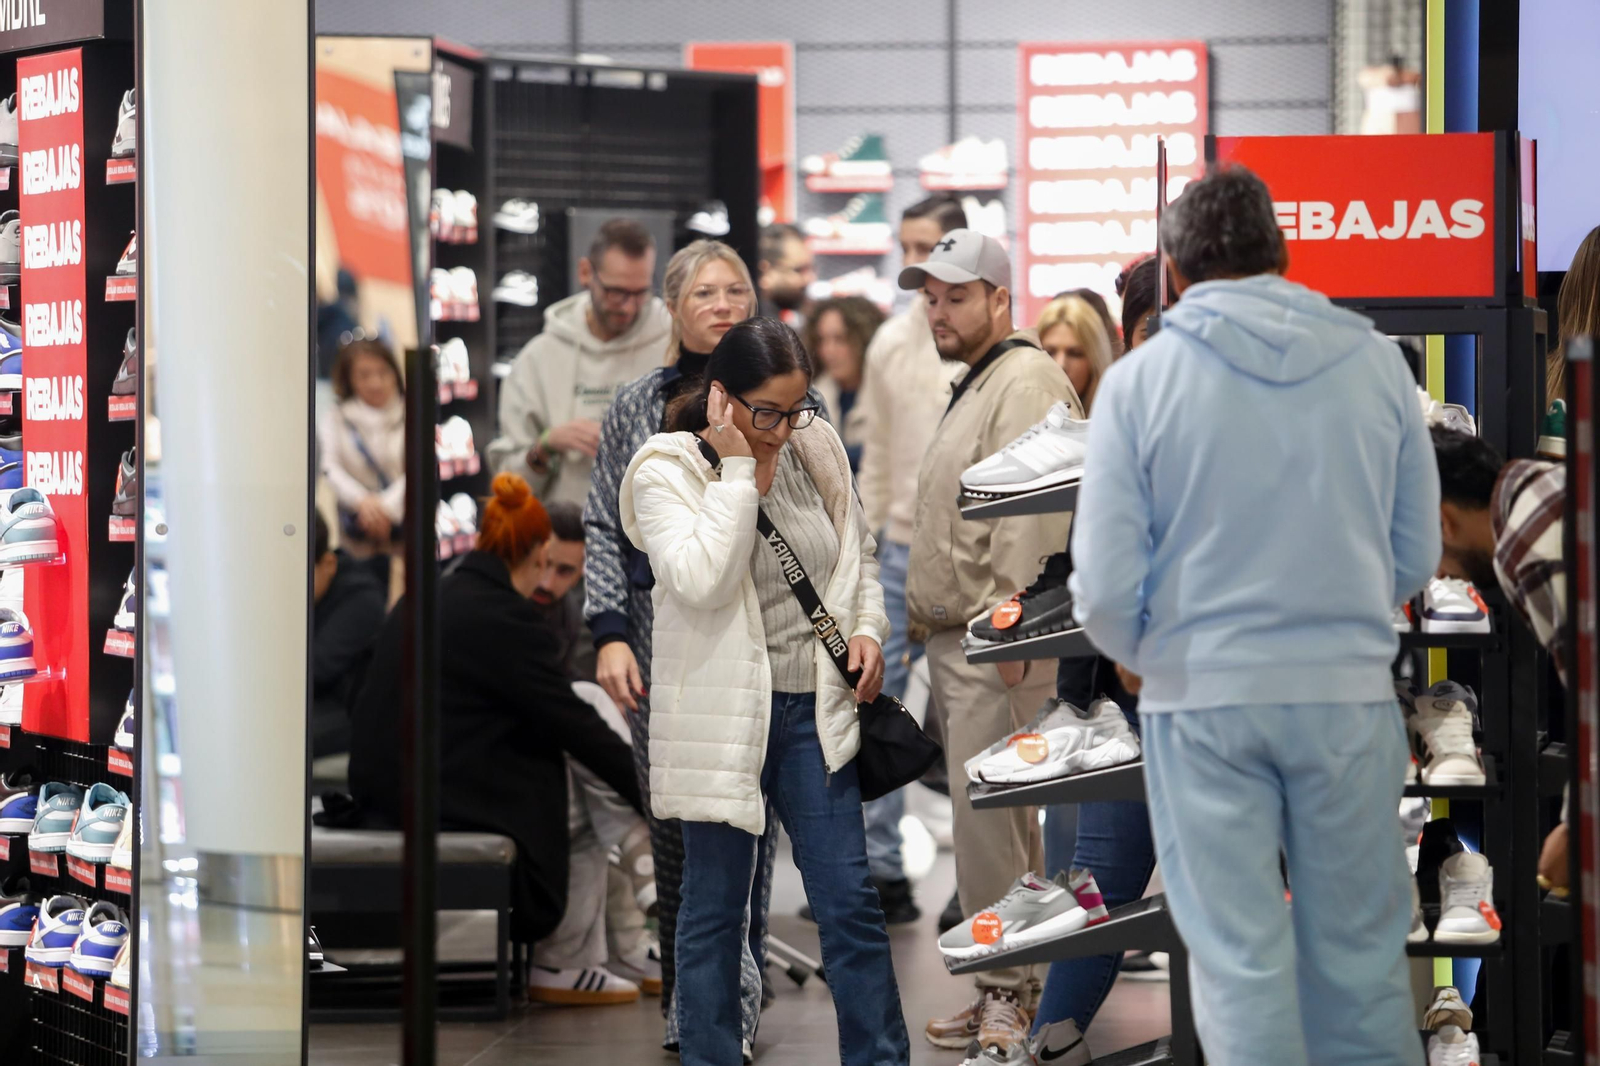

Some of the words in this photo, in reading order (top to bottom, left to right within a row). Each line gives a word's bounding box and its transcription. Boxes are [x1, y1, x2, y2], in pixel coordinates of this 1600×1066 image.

[21, 67, 79, 121] REBAJAS
[22, 144, 80, 195] REBAJAS
[1271, 198, 1485, 241] EBAJAS
[24, 220, 81, 269] REBAJAS
[25, 299, 82, 346] REBAJAS
[26, 375, 83, 420] REBAJAS
[27, 450, 83, 495] REBAJAS
[24, 504, 44, 515] NIKE
[767, 530, 805, 584] BIMBA
[2, 624, 19, 633] NIKE
[56, 797, 76, 807] NIKE
[103, 808, 123, 818] NIKE
[66, 912, 85, 922] NIKE
[102, 923, 121, 933] NIKE
